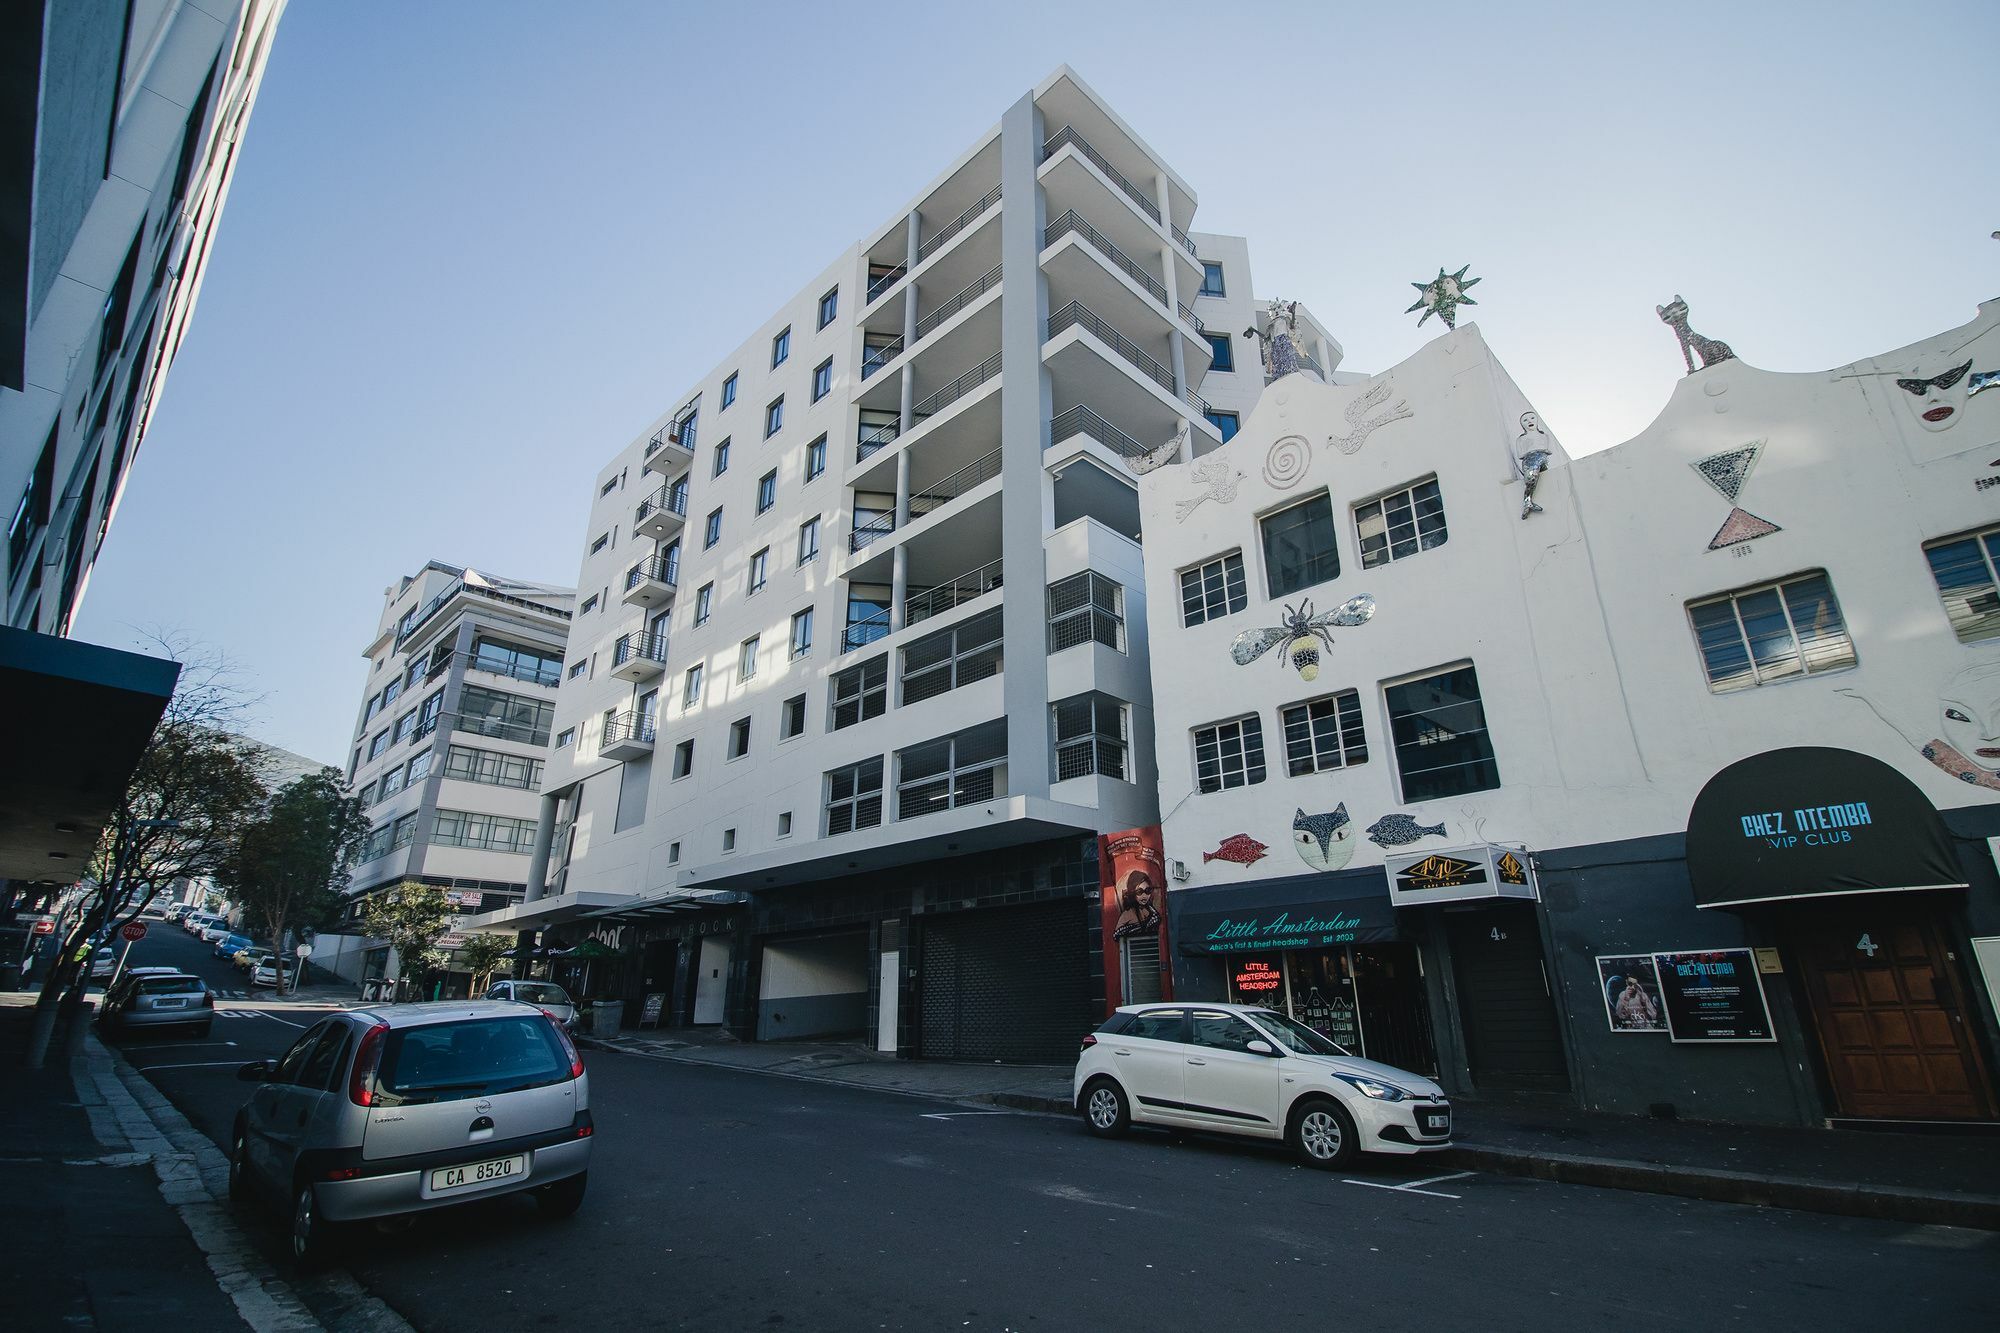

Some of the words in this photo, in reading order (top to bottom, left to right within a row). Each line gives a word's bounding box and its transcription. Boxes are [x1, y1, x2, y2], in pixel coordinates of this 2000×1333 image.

[1740, 812, 1788, 837] CHEZ
[1794, 802, 1872, 832] NTEMBA
[1769, 836, 1797, 849] VIP
[1805, 830, 1851, 846] CLUB
[123, 925, 146, 938] STOP
[1206, 919, 1259, 940] Little
[1262, 911, 1361, 935] Amsterdam
[1209, 942, 1234, 951] Africa's
[1234, 941, 1247, 950] first
[1247, 941, 1253, 949] &
[1253, 940, 1271, 949] finest
[1272, 938, 1309, 948] headshop
[1322, 935, 1333, 944] Est
[1335, 933, 1354, 943] 2003
[1857, 933, 1879, 957] 4
[1236, 971, 1281, 982] AMSTERDAM
[1245, 963, 1269, 972] LITTLE
[1239, 981, 1279, 992] HEADSHOP
[446, 1171, 465, 1186] CA
[476, 1160, 512, 1181] 8520
